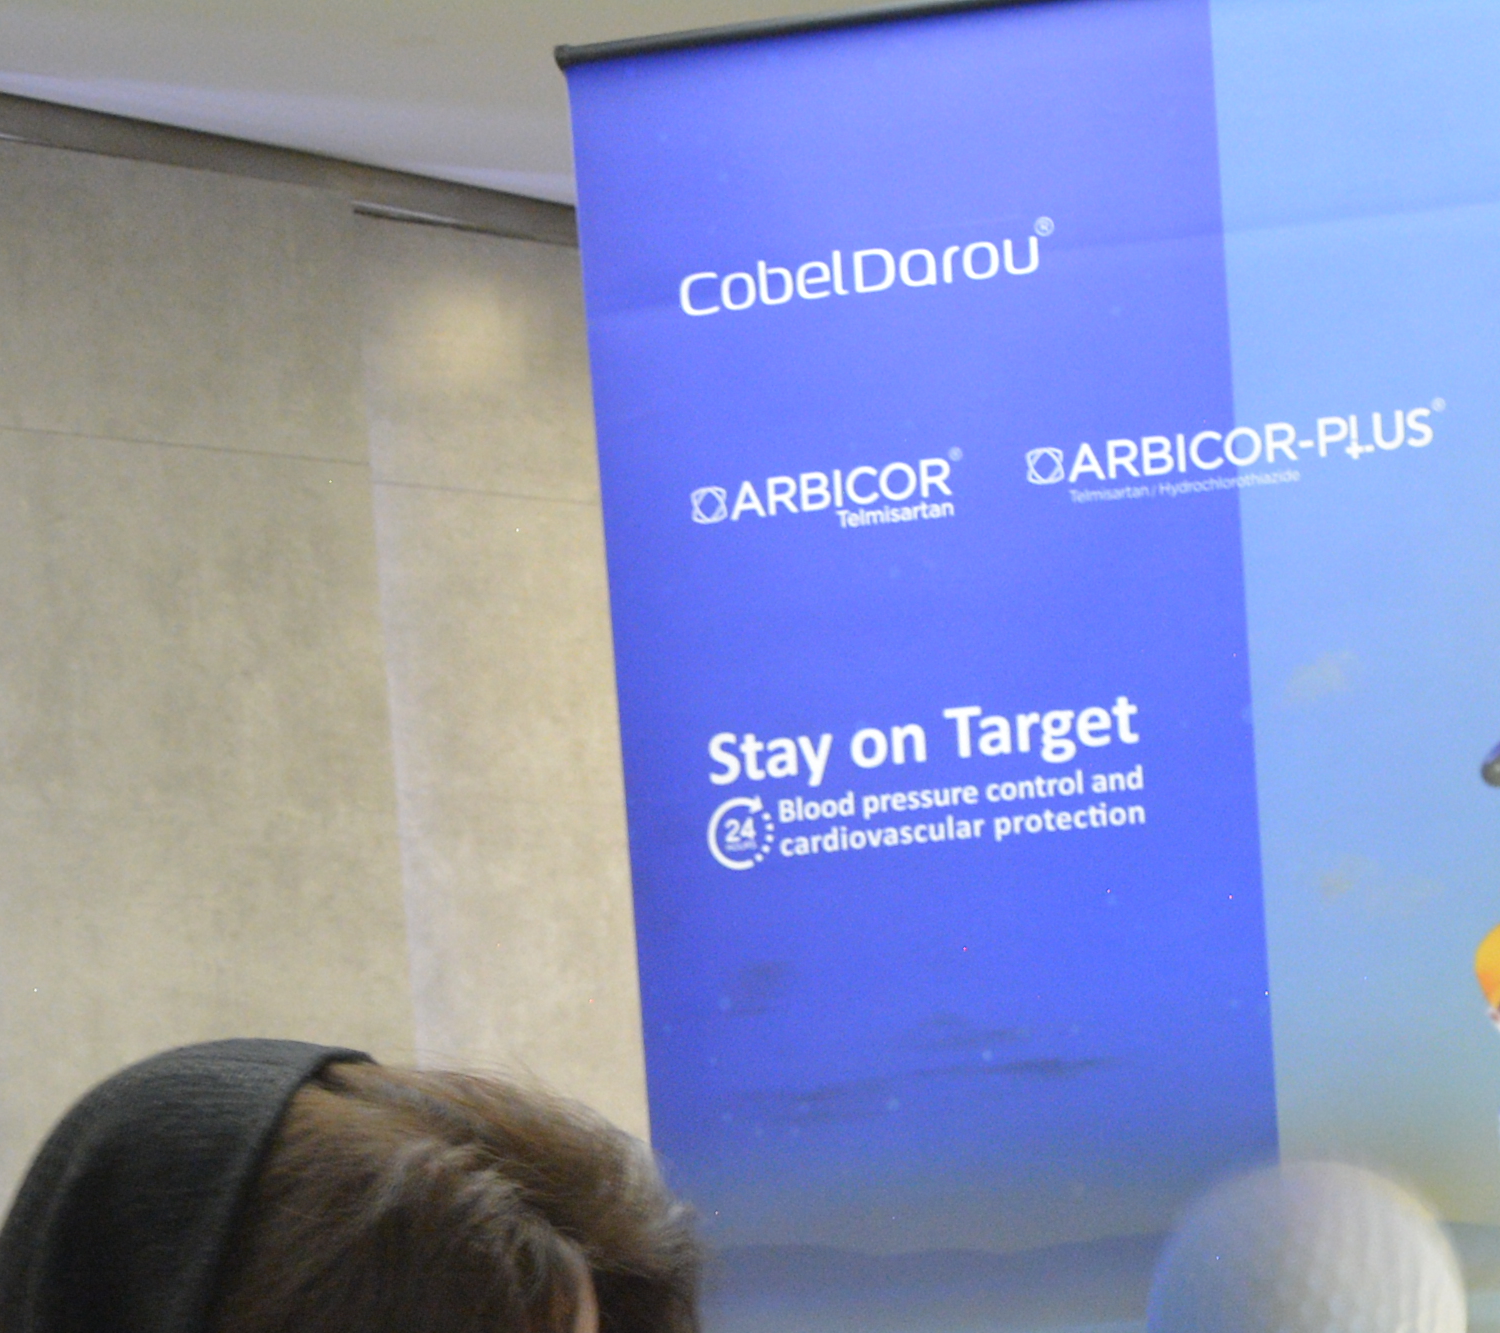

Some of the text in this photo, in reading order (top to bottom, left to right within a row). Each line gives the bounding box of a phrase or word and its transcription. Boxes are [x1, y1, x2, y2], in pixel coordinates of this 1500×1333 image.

[836, 500, 955, 529] Telmisartan
[1069, 483, 1151, 504] Telmisartan
[707, 696, 1140, 787] Stay on Target
[777, 764, 1145, 824] Blood pressure control and
[723, 816, 758, 845] 24
[778, 801, 1147, 858] cardiovascular protection
